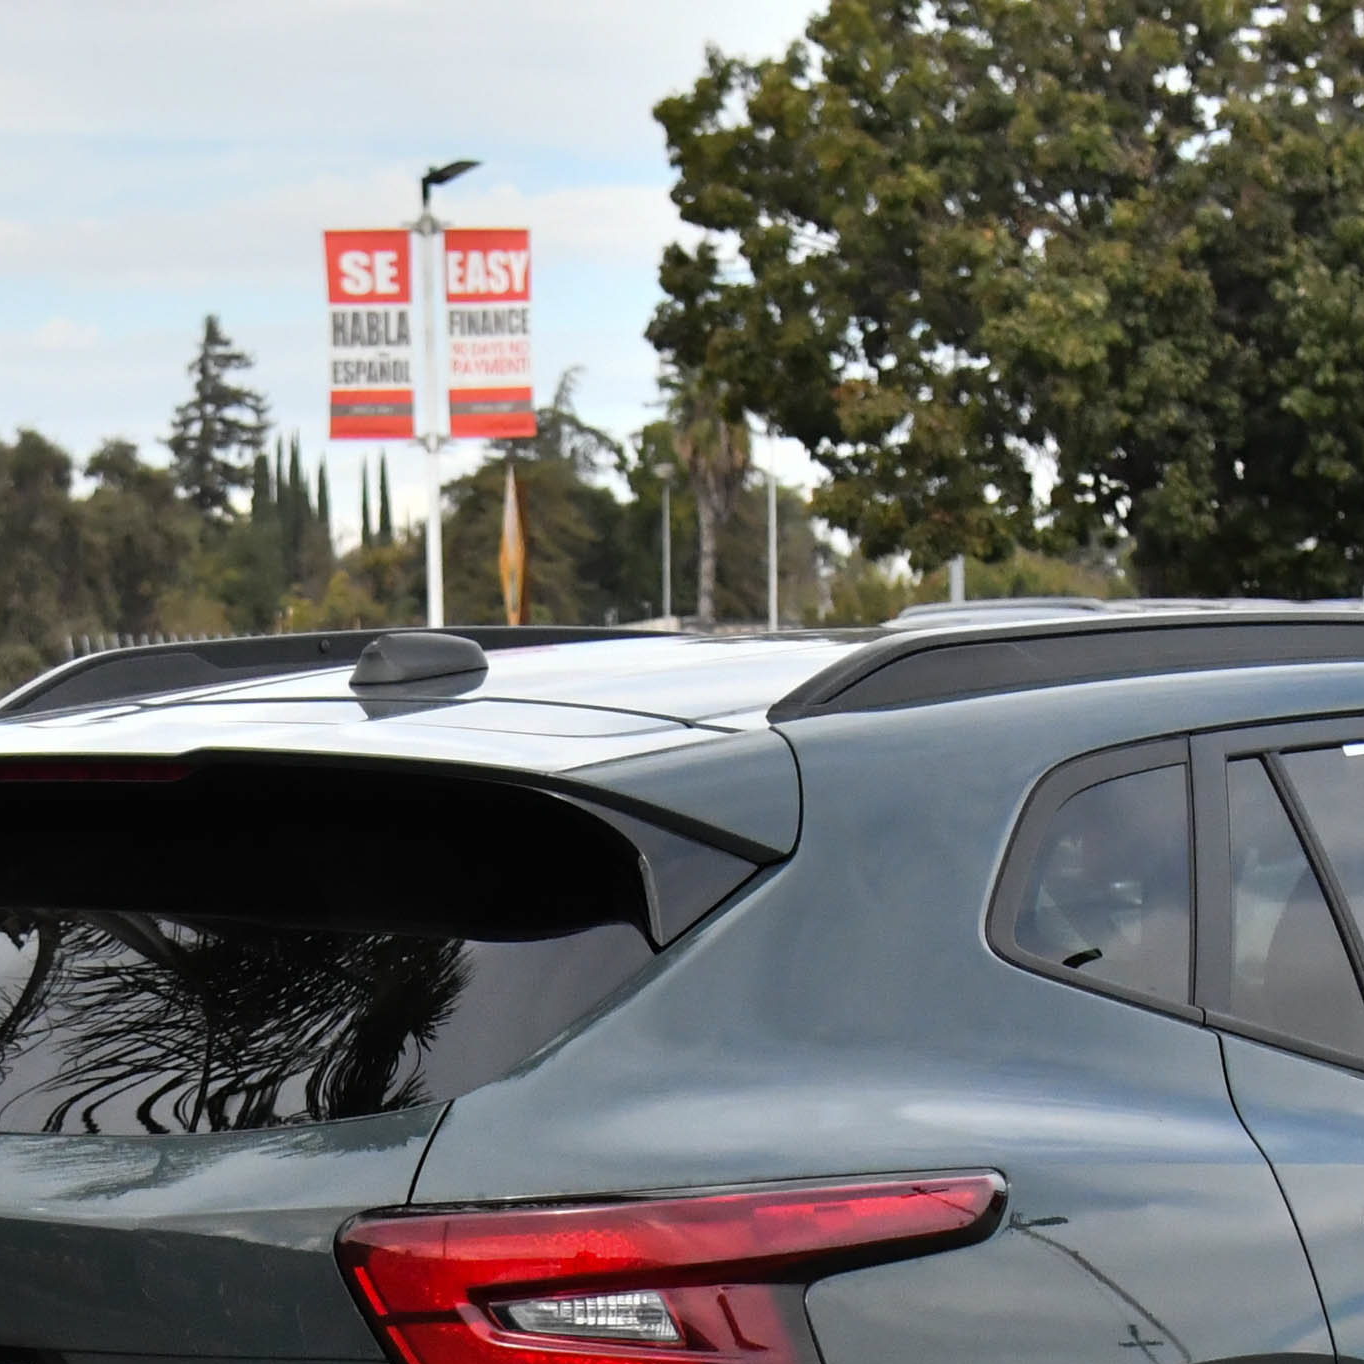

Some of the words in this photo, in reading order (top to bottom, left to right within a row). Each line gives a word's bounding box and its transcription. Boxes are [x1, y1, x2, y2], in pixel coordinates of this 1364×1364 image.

[339, 250, 401, 296] SE
[447, 249, 529, 295] EASY
[331, 309, 412, 347] HABLA
[448, 307, 529, 336] FINANCE
[331, 353, 412, 384] ESPAÑOL
